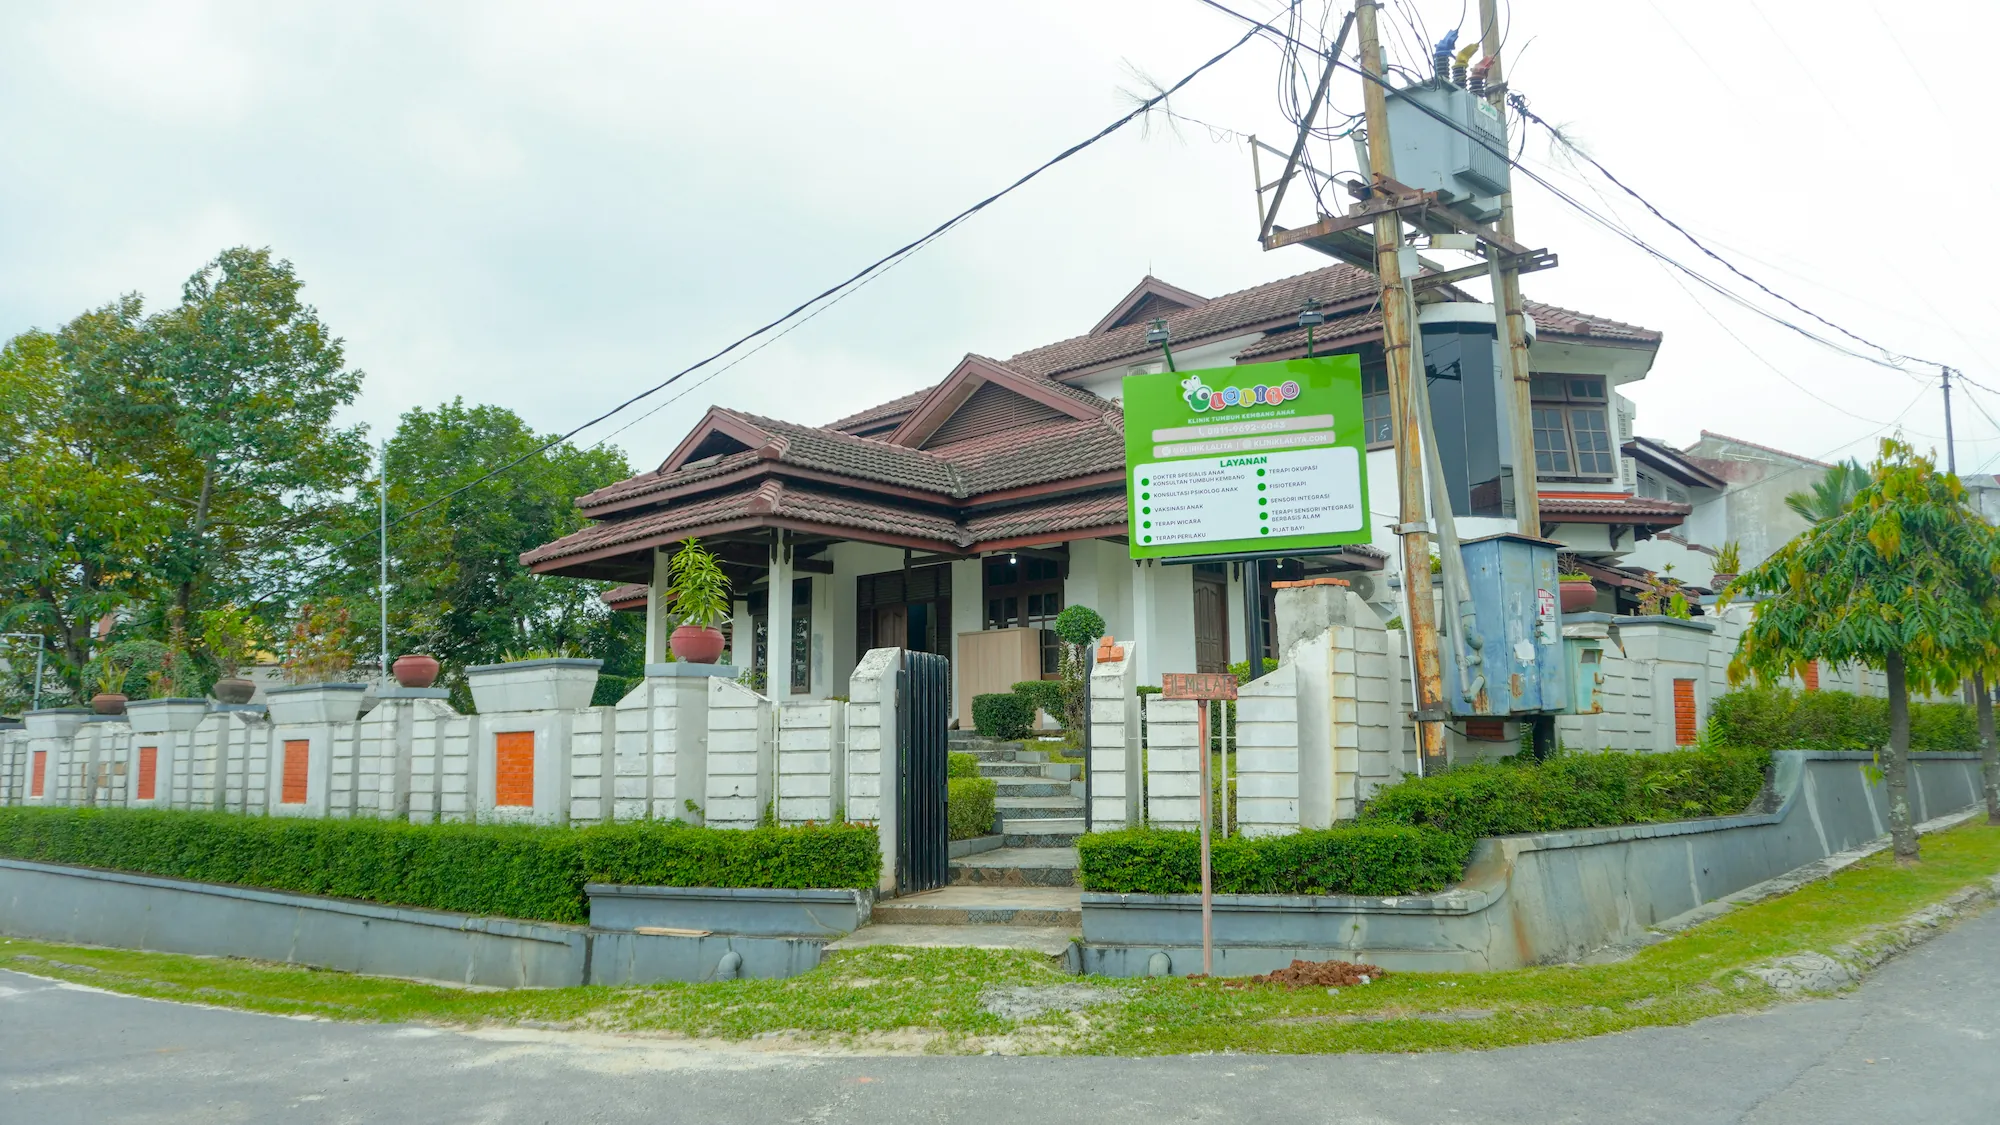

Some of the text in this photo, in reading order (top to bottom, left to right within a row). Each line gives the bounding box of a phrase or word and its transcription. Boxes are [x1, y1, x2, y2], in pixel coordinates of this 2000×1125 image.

[1220, 457, 1267, 467] LAYANAN
[1154, 490, 1190, 498] KONSULTASI
[1270, 496, 1297, 504] SENSORI
[1155, 505, 1186, 513] VAKSINASI
[1294, 506, 1321, 514] SENSORI
[1272, 515, 1302, 523] BERBASIS
